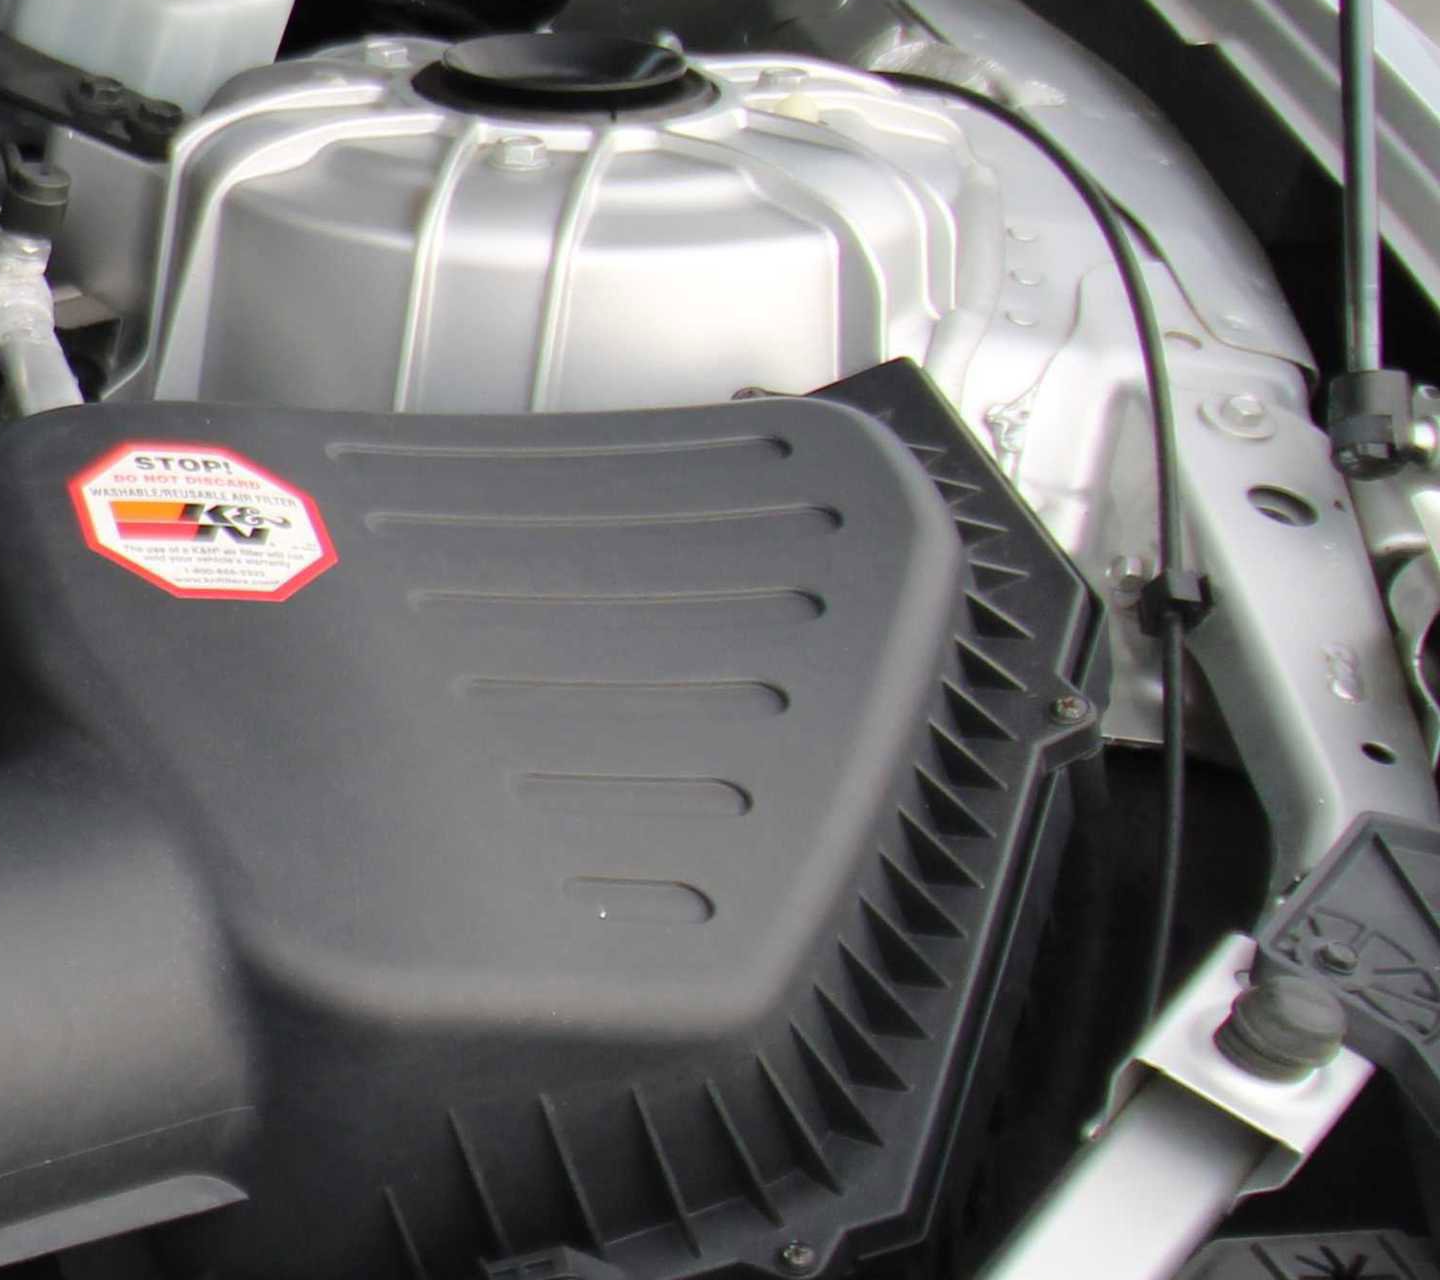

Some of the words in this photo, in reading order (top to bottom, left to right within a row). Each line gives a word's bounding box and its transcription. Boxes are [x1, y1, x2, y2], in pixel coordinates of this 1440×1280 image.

[133, 456, 233, 475] STOP!
[113, 474, 137, 484] DO
[143, 475, 178, 485] NOT
[185, 476, 261, 490] DISCARD
[90, 487, 229, 502] WASHABLE/REUSABLE
[231, 492, 253, 502] AIR
[255, 494, 298, 507] FILTER
[178, 502, 292, 547] K&N
